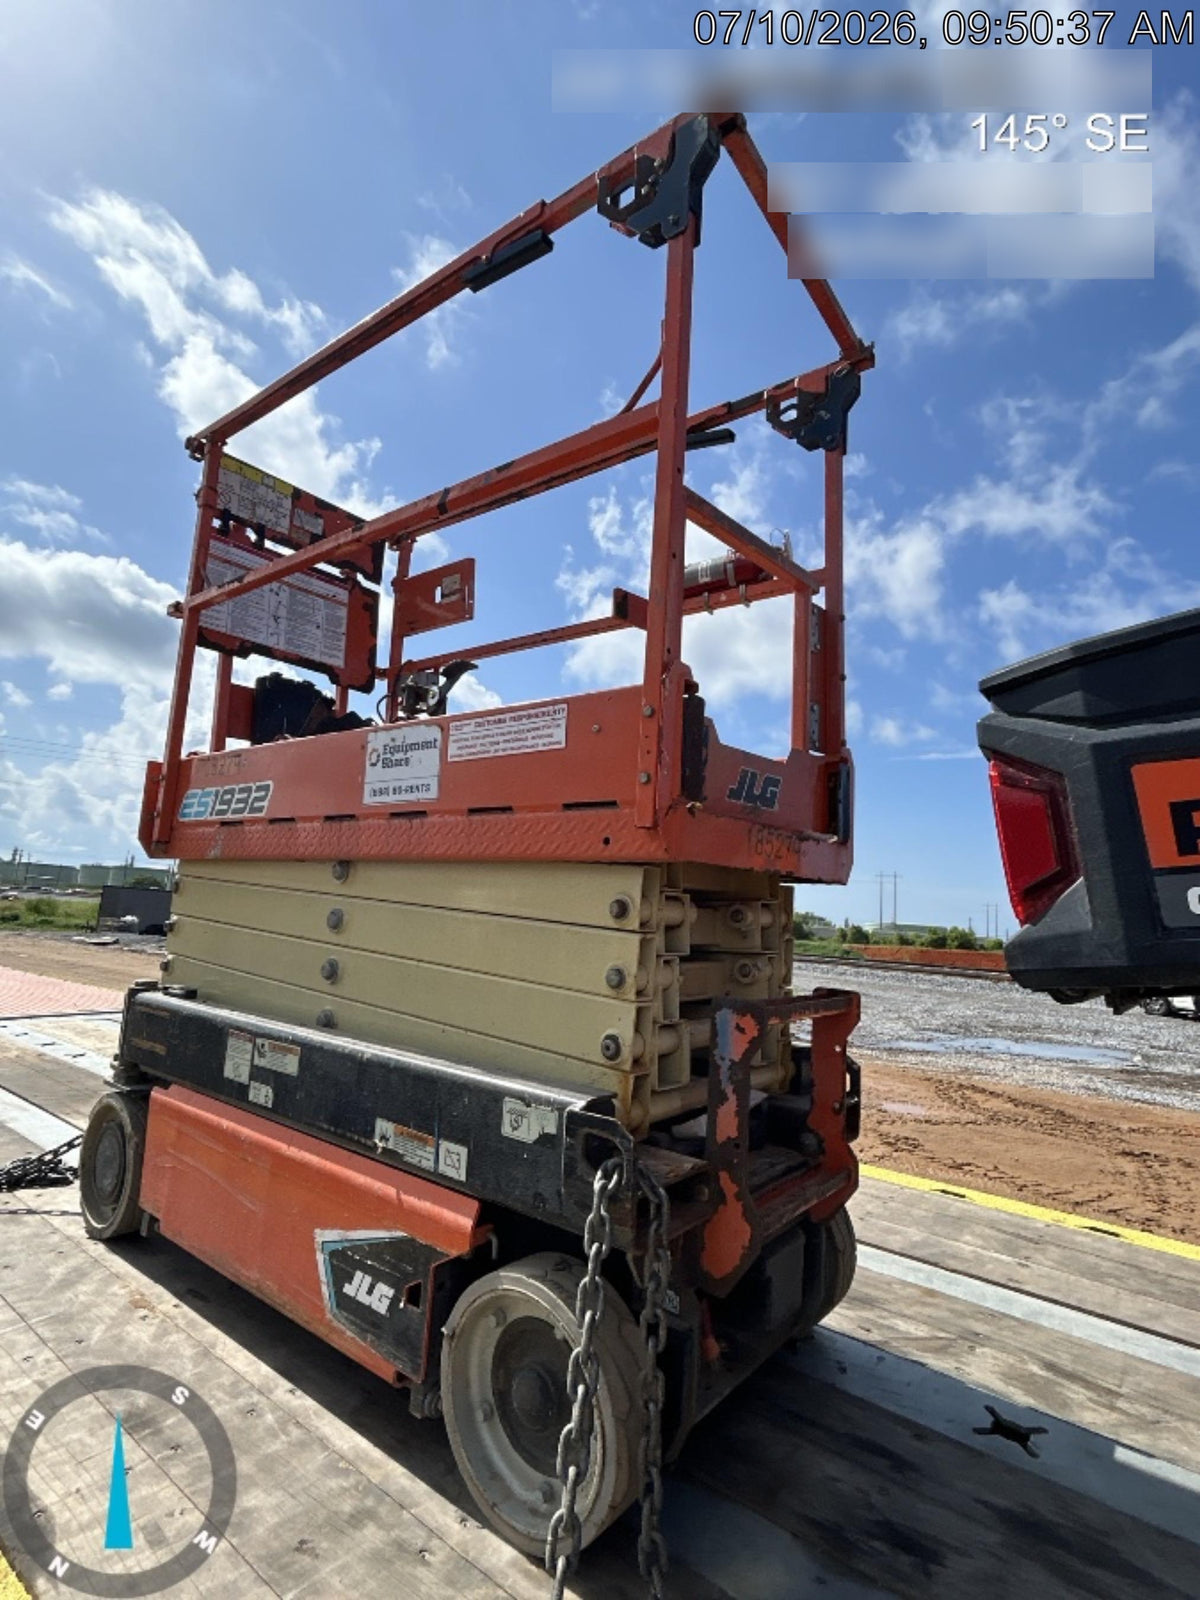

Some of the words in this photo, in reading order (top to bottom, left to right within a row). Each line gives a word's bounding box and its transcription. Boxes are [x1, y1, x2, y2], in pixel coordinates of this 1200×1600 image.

[381, 757, 410, 769] Share
[382, 737, 438, 757] Equipment
[179, 782, 273, 819] ES1932
[726, 767, 782, 811] JLG
[342, 1269, 395, 1316] JLG
